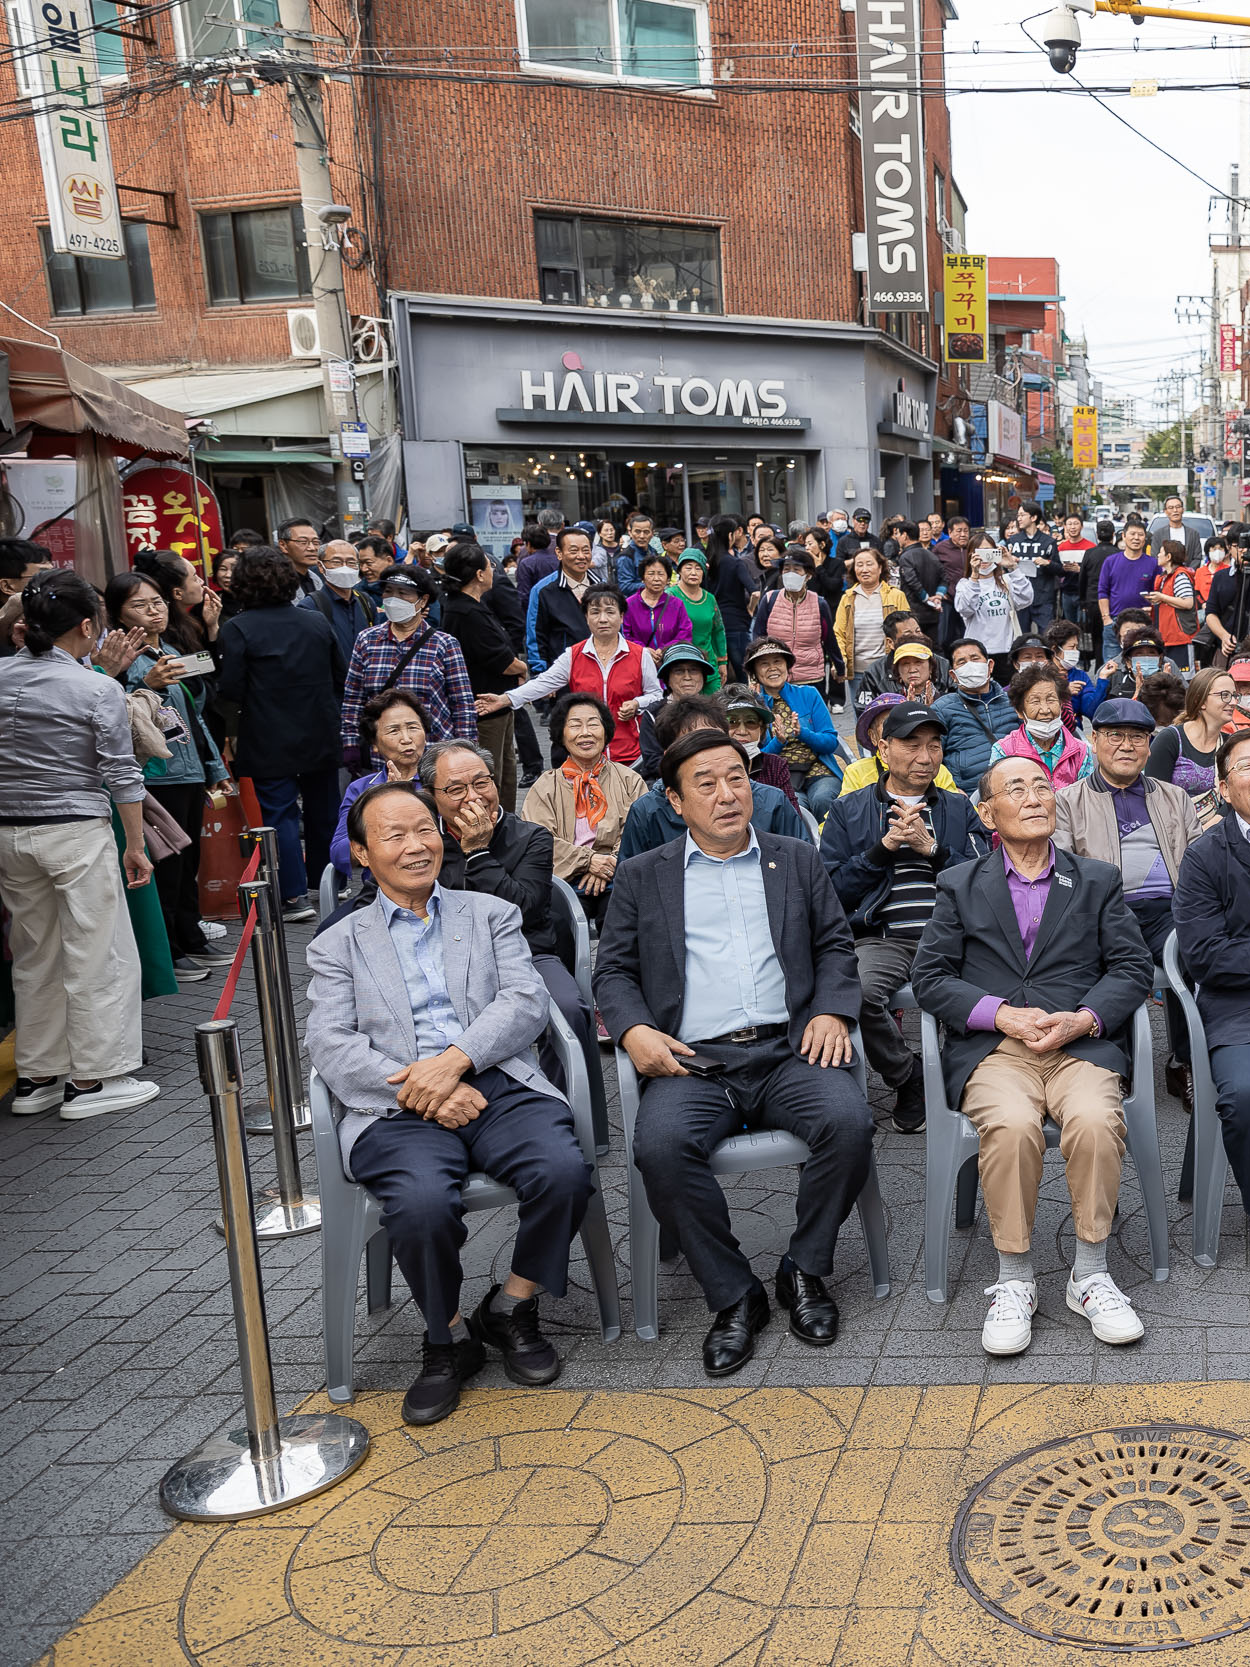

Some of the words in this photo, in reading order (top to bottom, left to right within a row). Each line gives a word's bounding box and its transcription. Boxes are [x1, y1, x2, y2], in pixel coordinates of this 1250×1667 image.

[868, 1, 909, 122] HAIR
[69, 178, 104, 220] 쌀
[872, 133, 916, 274] TOMS
[69, 233, 119, 253] 497-4225
[946, 256, 985, 271] 부뚜막
[873, 290, 923, 304] 466.9336
[952, 273, 977, 332] 쭈꾸미
[519, 369, 646, 415] HAIR
[652, 375, 788, 418] TOMS
[986, 608, 1007, 617] TRACK
[858, 690, 873, 706] 45
